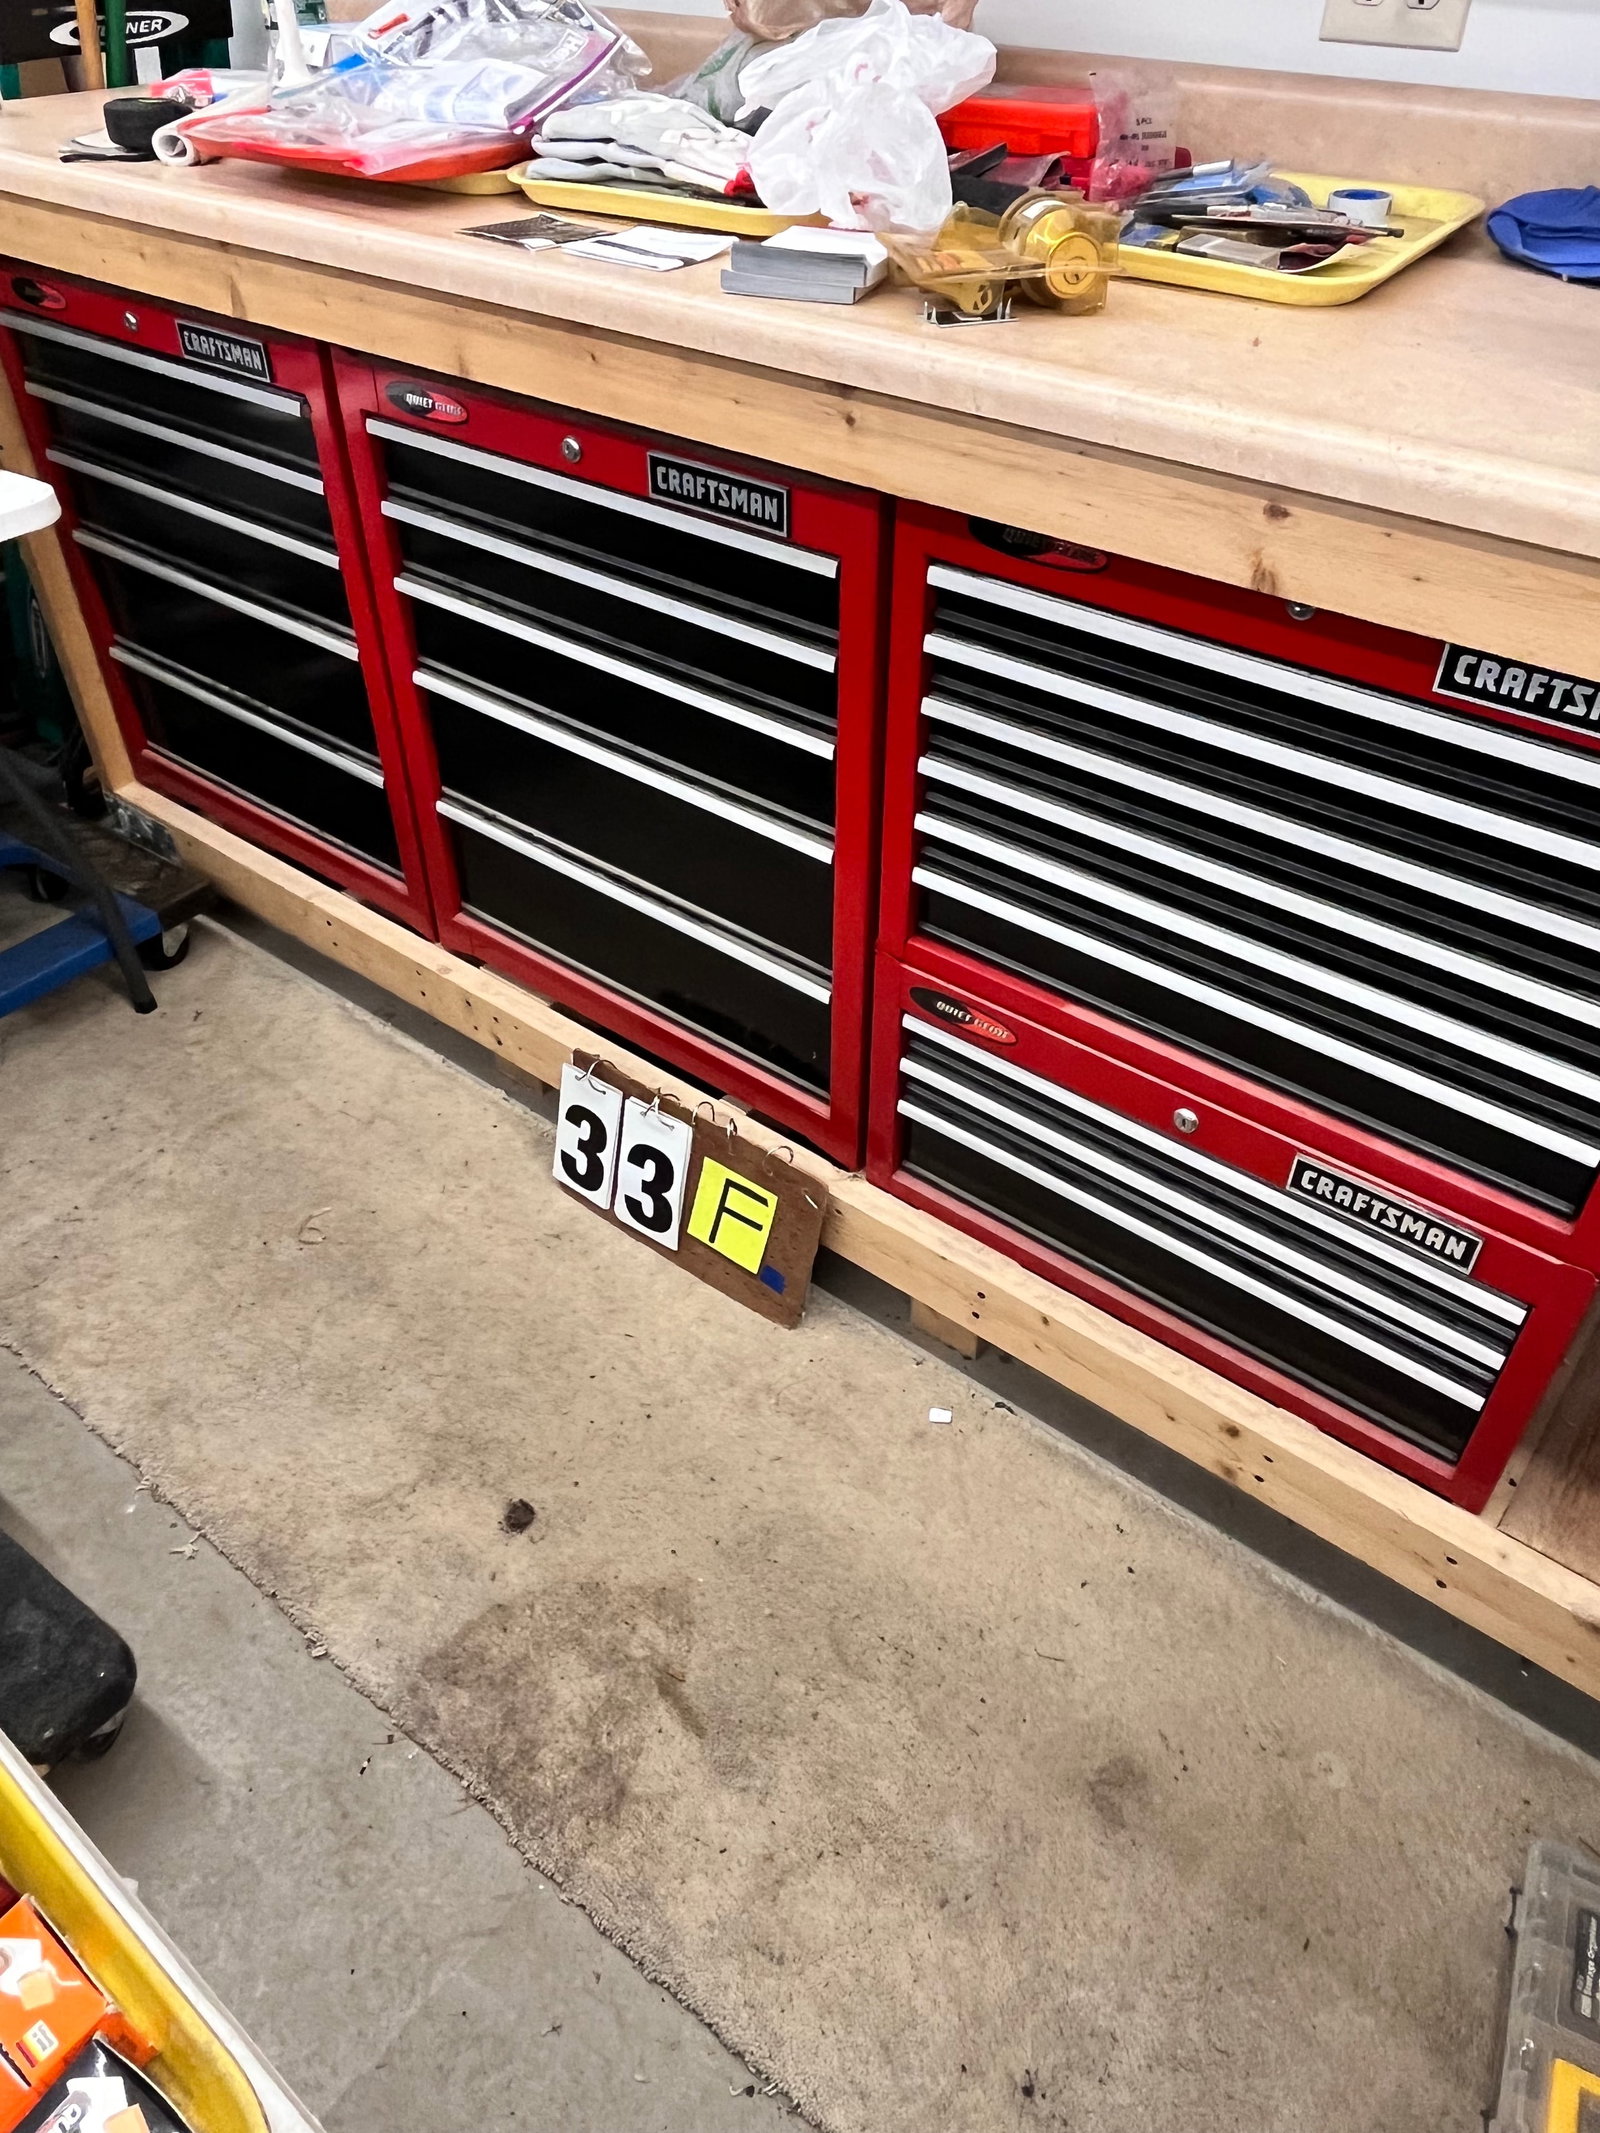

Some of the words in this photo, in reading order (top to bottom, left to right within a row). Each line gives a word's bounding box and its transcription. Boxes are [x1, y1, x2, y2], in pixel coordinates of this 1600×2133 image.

[183, 330, 263, 371] CRAFTSMAN
[405, 393, 433, 409] QUIET
[656, 466, 778, 523] CRAFTSMAN
[1453, 654, 1600, 721] CRAFTS
[708, 1177, 770, 1244] F
[1301, 1170, 1467, 1260] CRAFTSMAN
